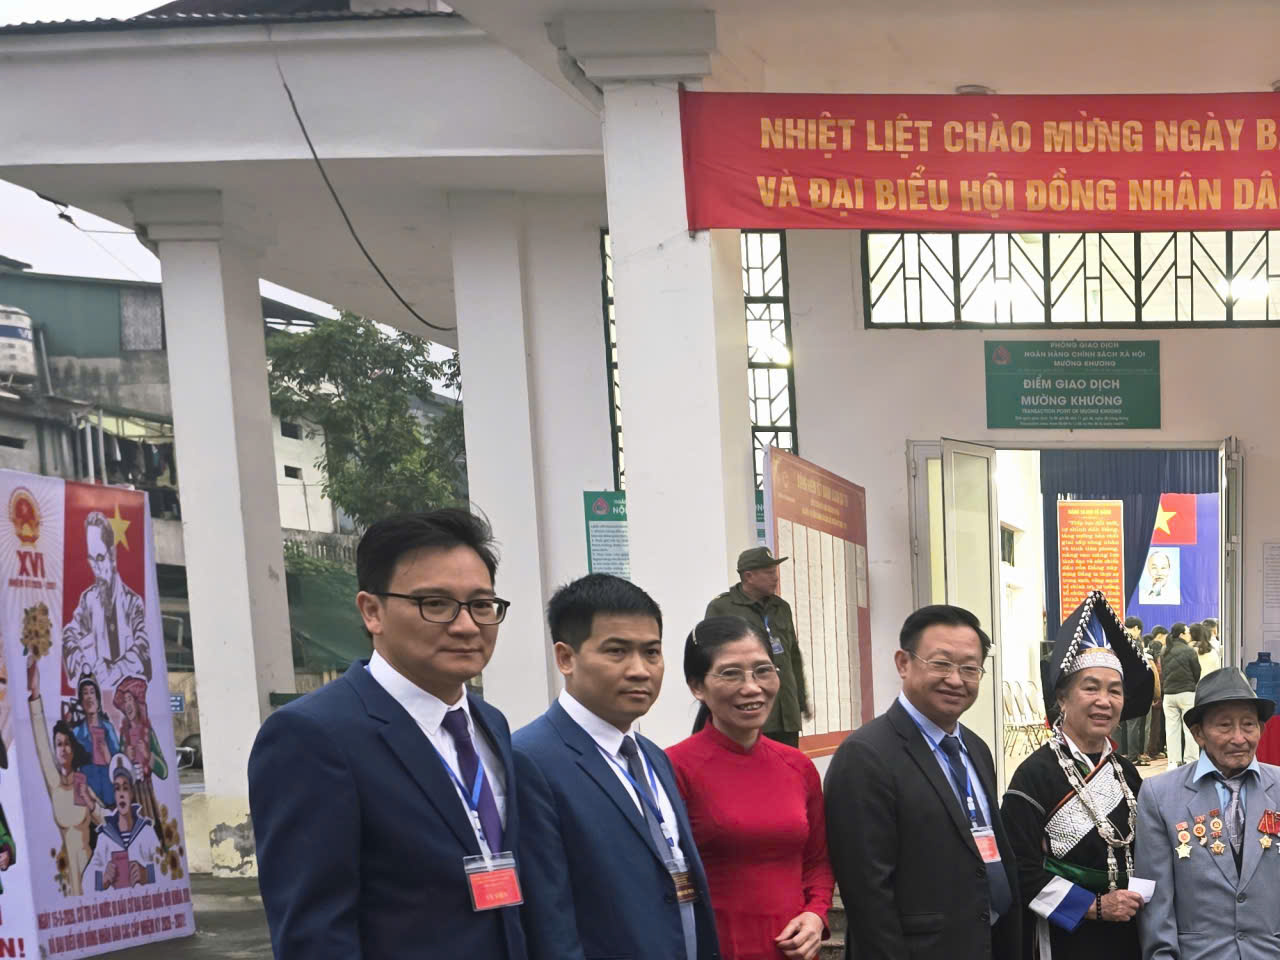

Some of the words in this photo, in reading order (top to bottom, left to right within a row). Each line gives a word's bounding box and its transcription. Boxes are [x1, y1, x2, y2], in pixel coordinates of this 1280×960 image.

[760, 111, 855, 159] NHIỆT
[866, 112, 933, 159] LIỆT
[943, 112, 1032, 154] CHÀO
[1043, 110, 1144, 154] MỪNG
[1154, 110, 1244, 154] NGÀY
[756, 169, 801, 209] VÀ
[809, 176, 865, 217] ĐẠI
[875, 165, 951, 212] BIỂU
[959, 170, 1016, 218] HỘI
[1024, 167, 1118, 213] ĐỒNG
[1127, 170, 1223, 213] NHÂN
[1023, 374, 1052, 390] ĐIỂM
[1055, 379, 1087, 390] GIAO
[1090, 379, 1120, 392] DỊCH
[1020, 393, 1067, 406] MƯỜNG
[1070, 394, 1122, 406] KHƯƠNG
[16, 550, 46, 578] XVI
